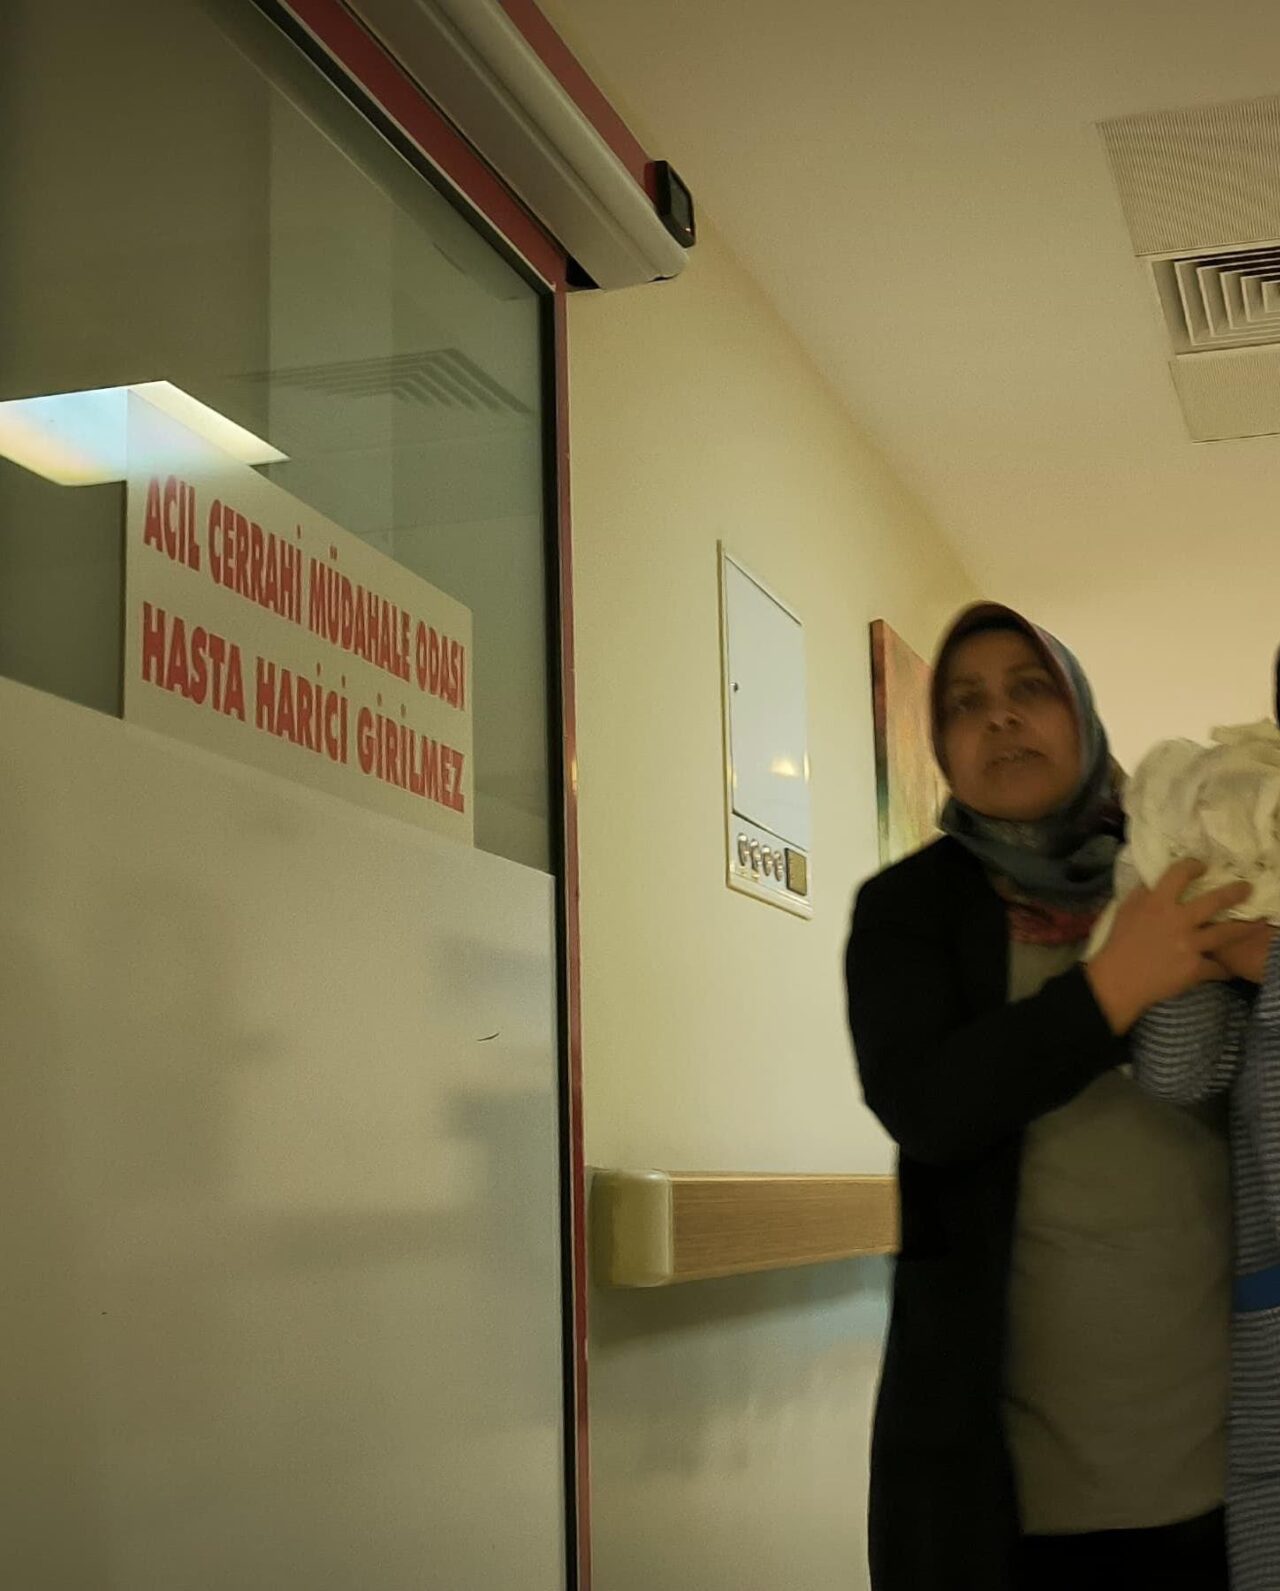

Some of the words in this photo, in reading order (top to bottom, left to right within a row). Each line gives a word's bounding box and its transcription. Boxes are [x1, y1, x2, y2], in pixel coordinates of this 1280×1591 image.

[142, 602, 246, 721] HASTA
[255, 655, 350, 765] HARİCİ
[357, 694, 465, 813] GİRİLMEZ
[209, 499, 302, 623] CERRAHİ
[307, 545, 412, 683] MÜDAHALE
[414, 620, 467, 712] ODASI
